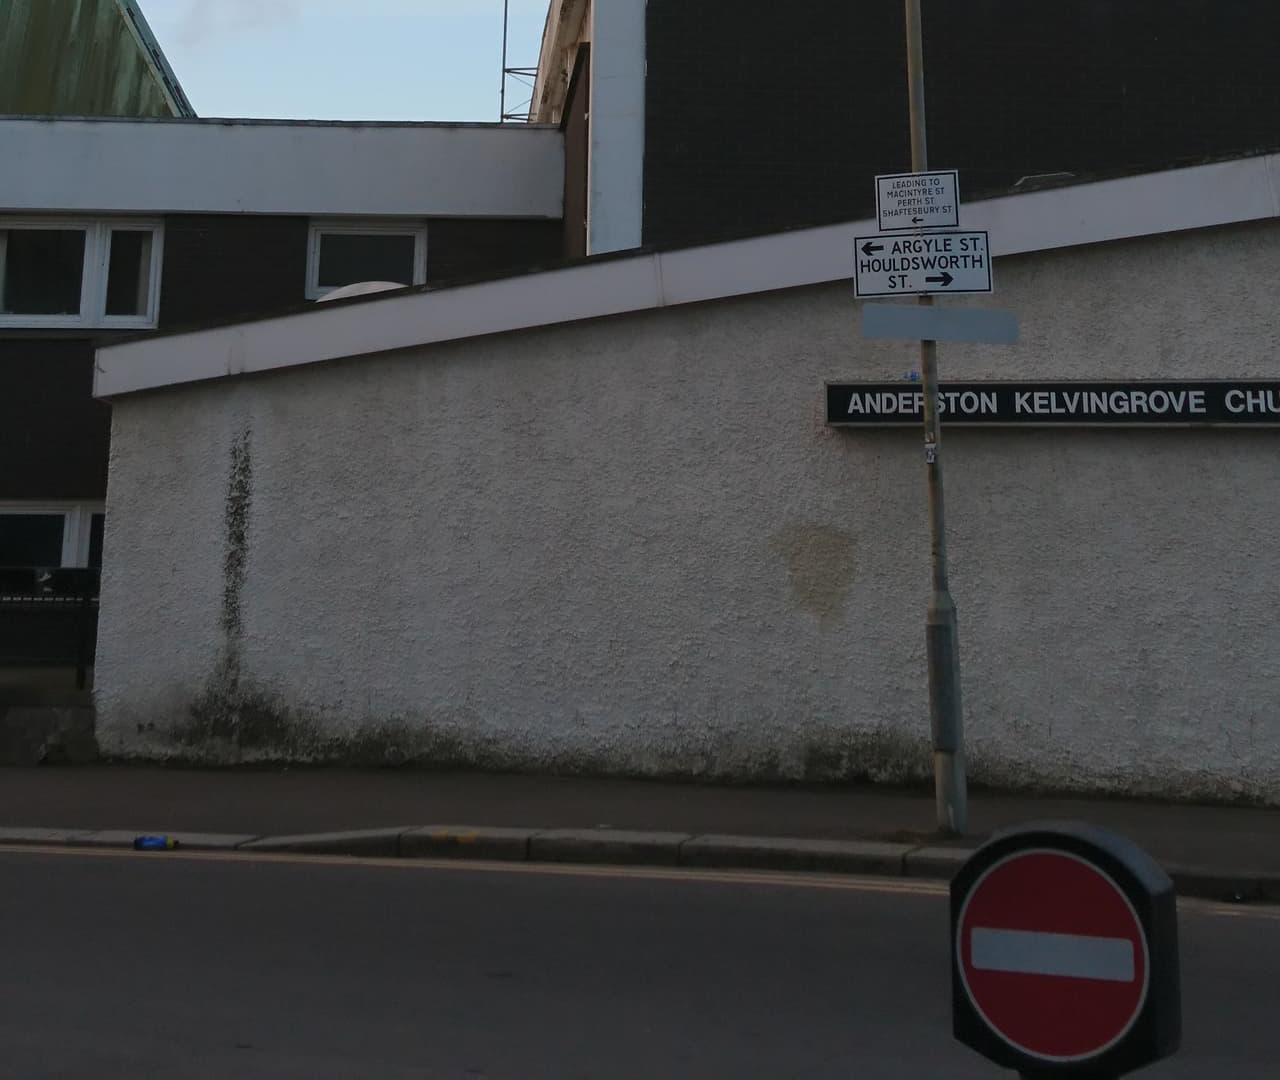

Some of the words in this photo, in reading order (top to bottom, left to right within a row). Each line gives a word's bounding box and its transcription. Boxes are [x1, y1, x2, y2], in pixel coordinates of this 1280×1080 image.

[892, 179, 927, 189] LEADING
[929, 178, 940, 186] TO
[886, 188, 933, 198] MACINTYRE
[935, 187, 945, 195] ST
[897, 199, 922, 207] PERTH
[925, 197, 935, 205] ST
[882, 206, 940, 217] SHAFTESBURY
[942, 205, 952, 214] ST
[891, 238, 952, 254] ARGYLE
[959, 237, 984, 251] ST.
[860, 255, 983, 273] HOULDSWORTH
[888, 274, 912, 288] ST.
[1015, 390, 1207, 414] KELVINGROVE
